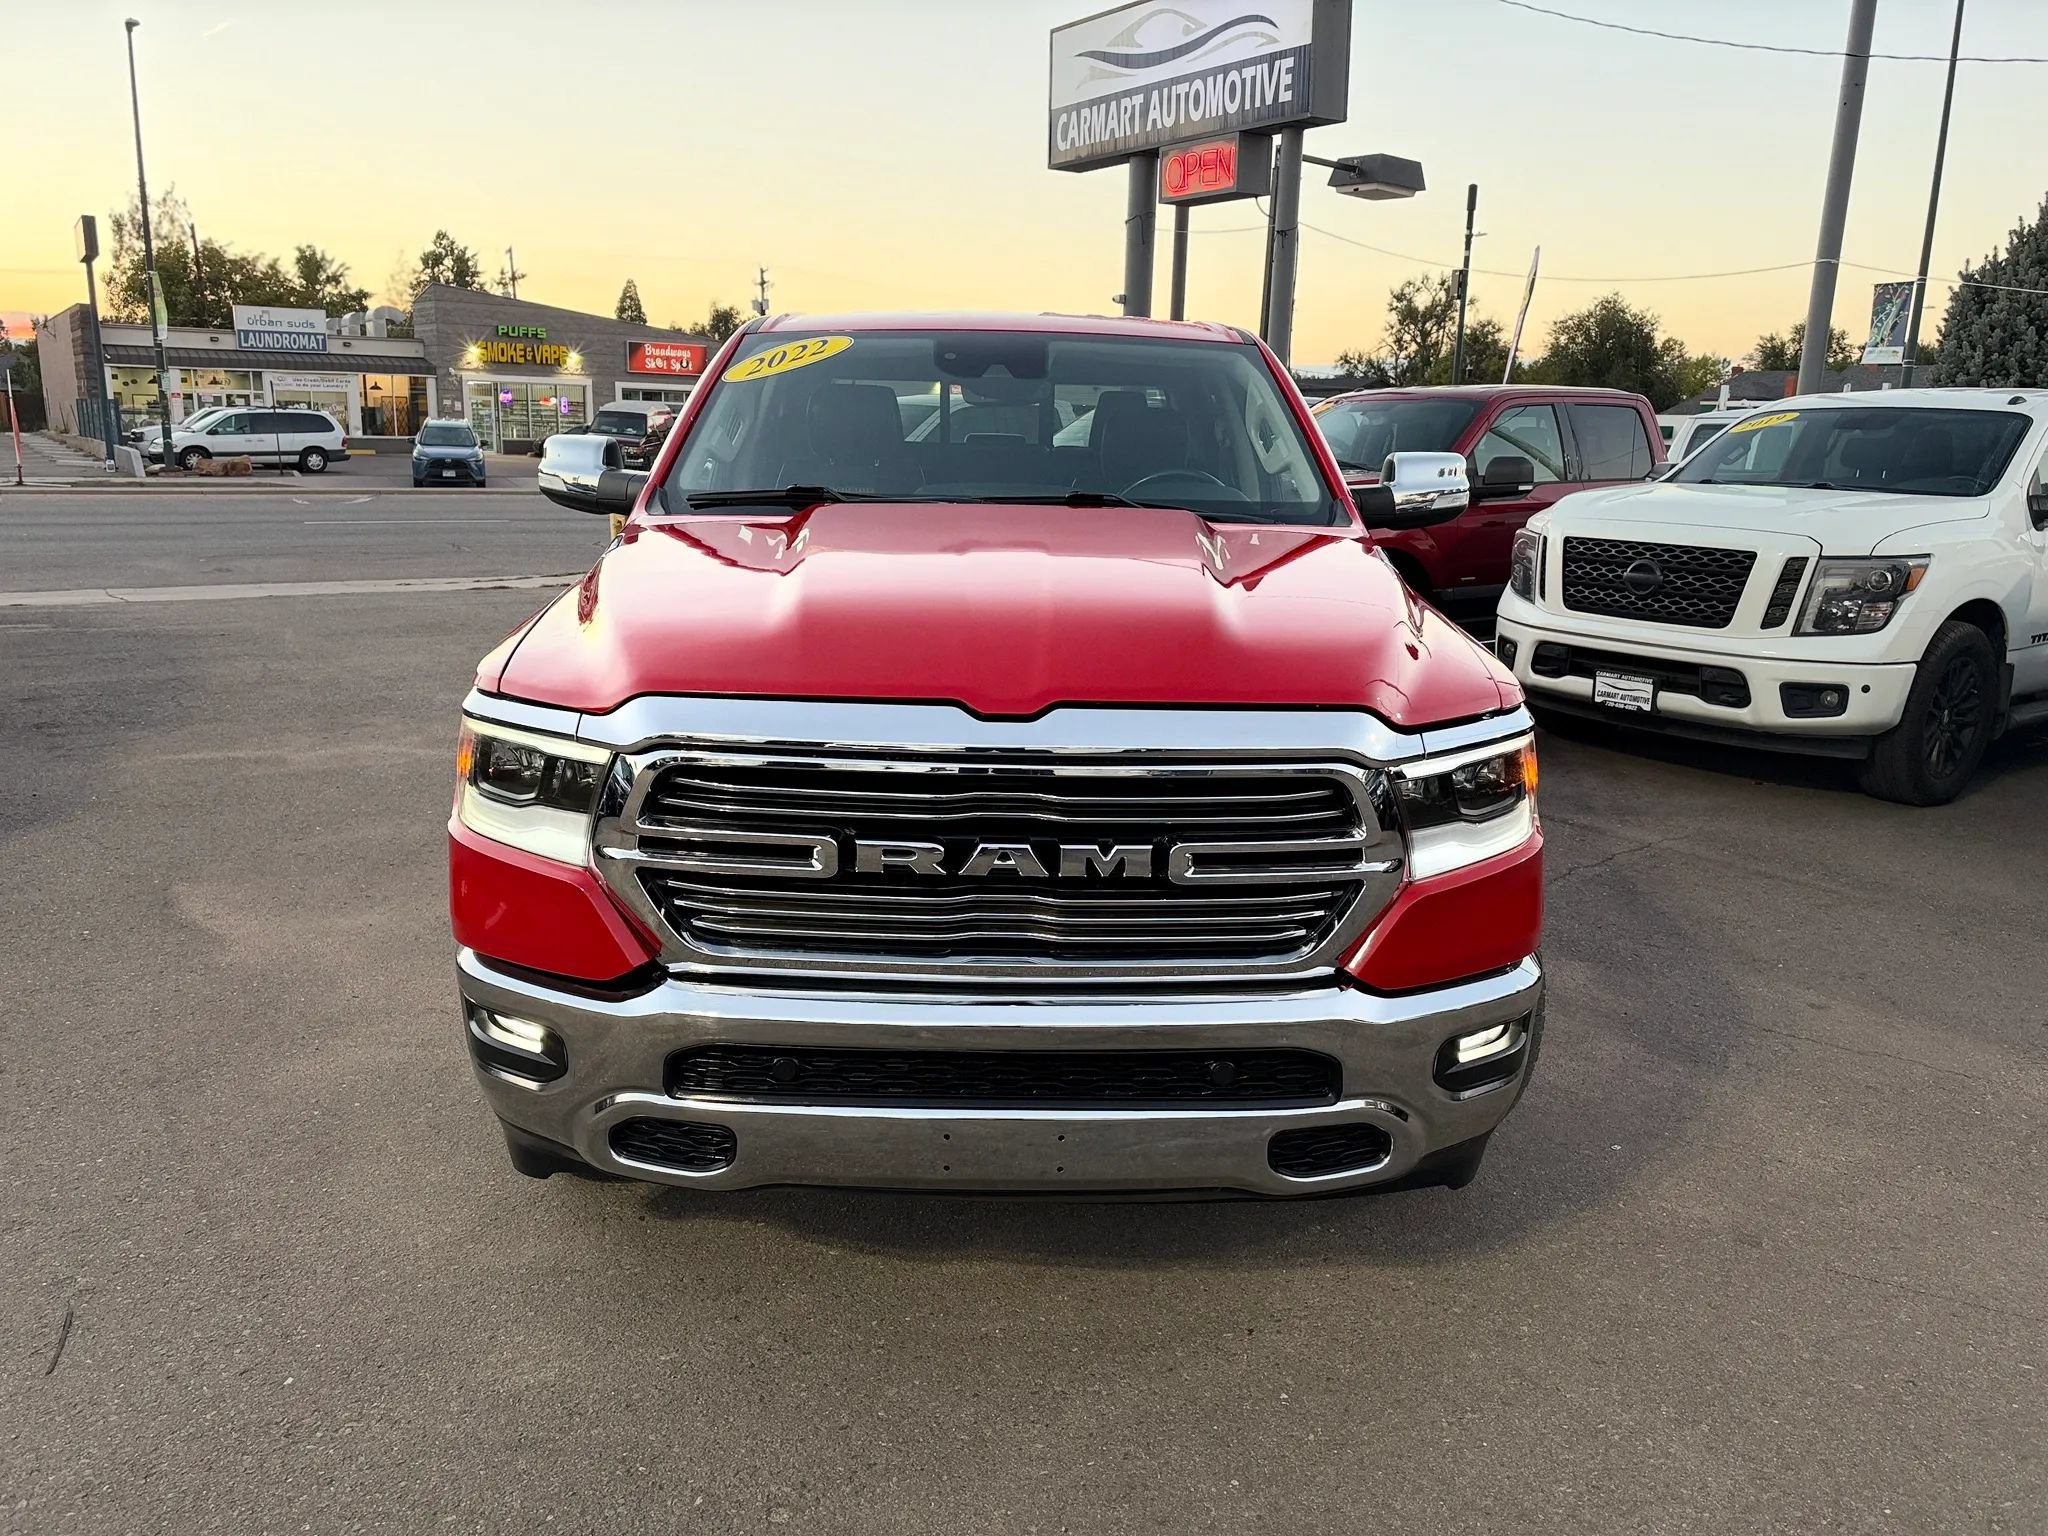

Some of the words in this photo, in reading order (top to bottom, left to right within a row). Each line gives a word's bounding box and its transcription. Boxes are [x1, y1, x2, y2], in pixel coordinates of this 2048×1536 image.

[1056, 93, 1144, 151] CARMART
[1146, 56, 1295, 132] AUTOMOTIVE
[1165, 145, 1236, 193] OPEN
[287, 319, 316, 329] suds
[497, 325, 547, 339] PUFFS
[240, 331, 325, 350] LAUNDROMAT
[480, 341, 525, 363] SMOKE
[526, 347, 534, 360] &
[533, 344, 568, 367] VAPE
[644, 343, 692, 359] Broadways
[745, 339, 829, 377] 2022
[1621, 674, 1653, 684] AUTOMOTIVE
[1597, 690, 1620, 699] CARMART
[1620, 694, 1651, 704] AUTOMOTIVE
[855, 840, 1153, 878] RAM
